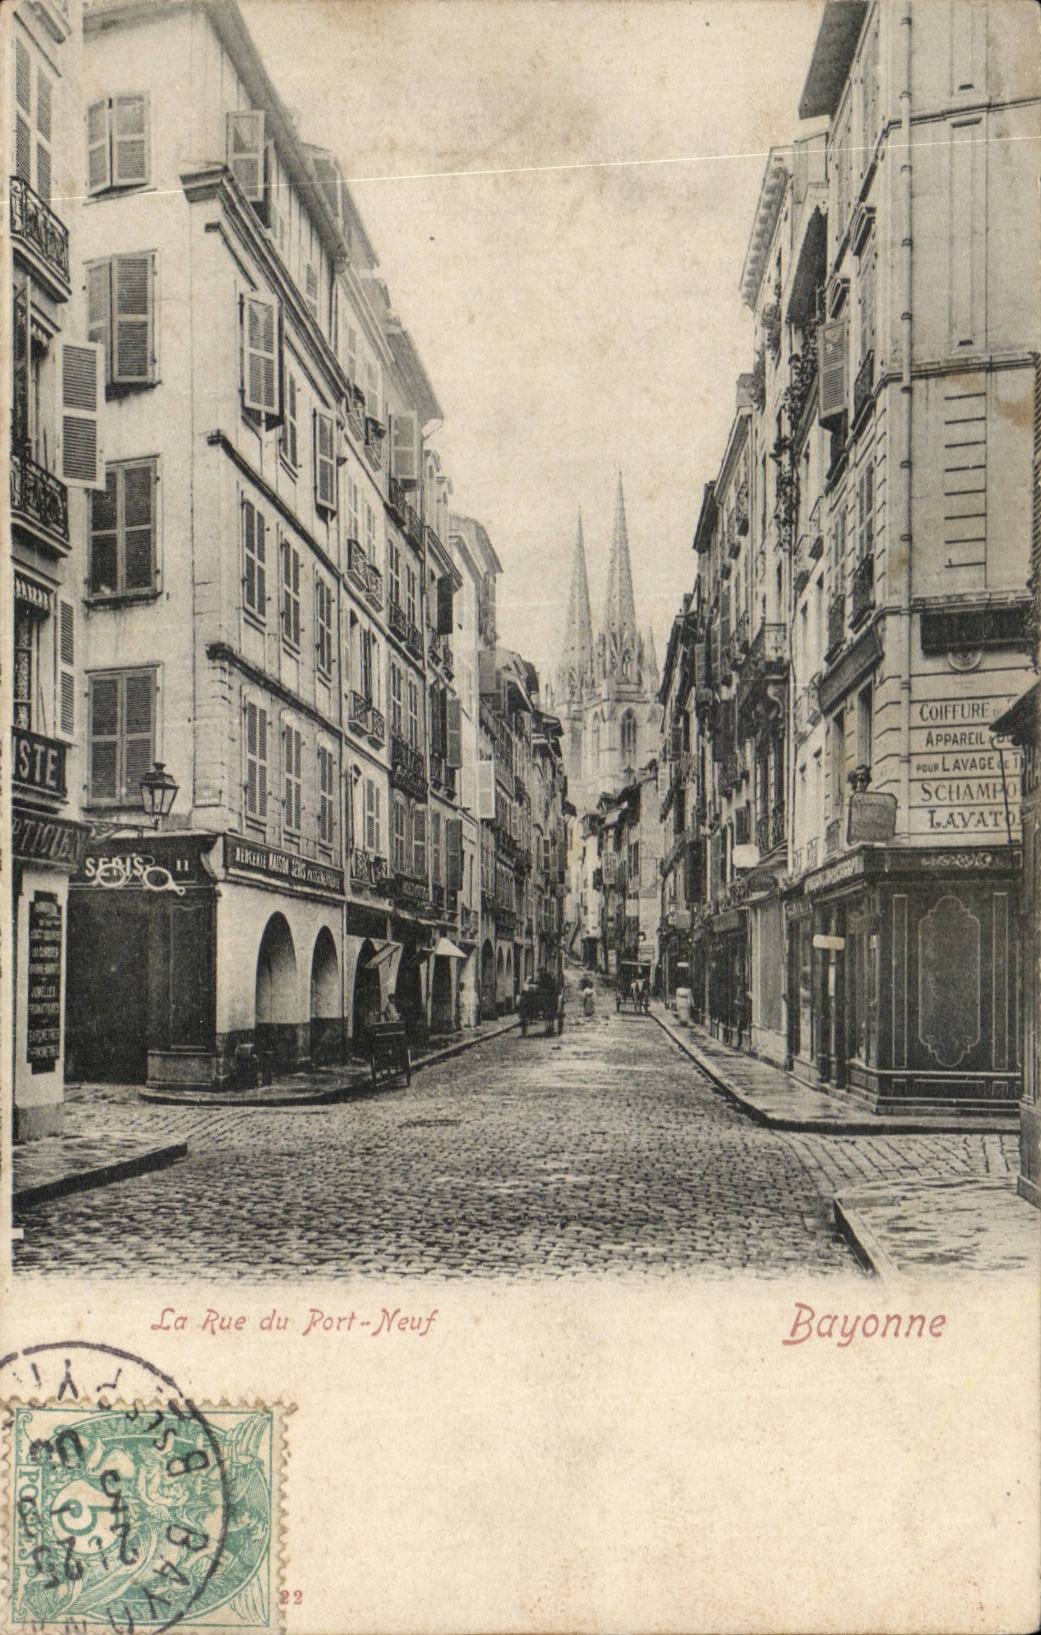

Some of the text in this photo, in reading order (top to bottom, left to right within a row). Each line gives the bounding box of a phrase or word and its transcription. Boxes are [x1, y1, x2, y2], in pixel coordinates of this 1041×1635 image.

[919, 702, 990, 721] COIFFURE
[925, 731, 986, 747] APPAREIL
[942, 755, 995, 773] LAVAGE
